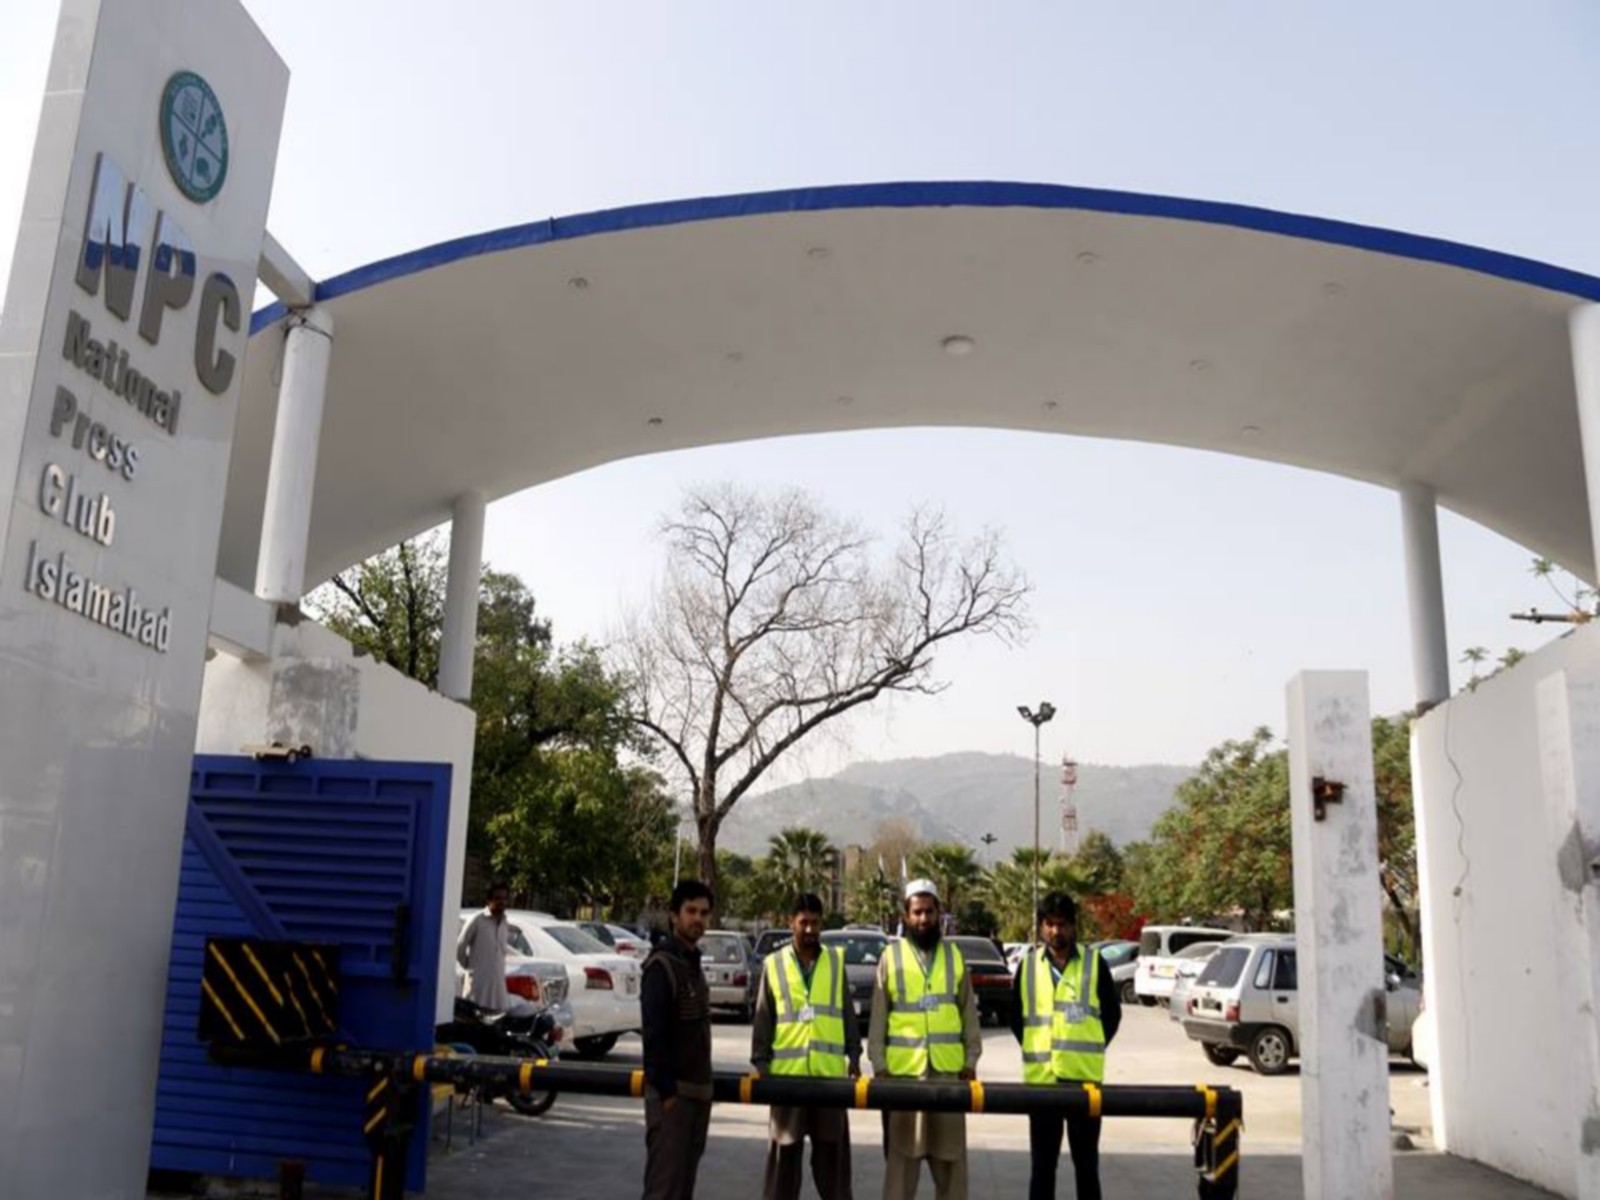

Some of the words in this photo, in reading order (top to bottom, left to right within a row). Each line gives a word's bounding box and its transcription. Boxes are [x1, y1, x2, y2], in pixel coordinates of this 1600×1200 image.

[76, 152, 241, 396] NPC
[62, 309, 181, 436] National
[49, 385, 139, 481] Press
[39, 462, 116, 547] Club
[24, 540, 172, 653] Islamabad
